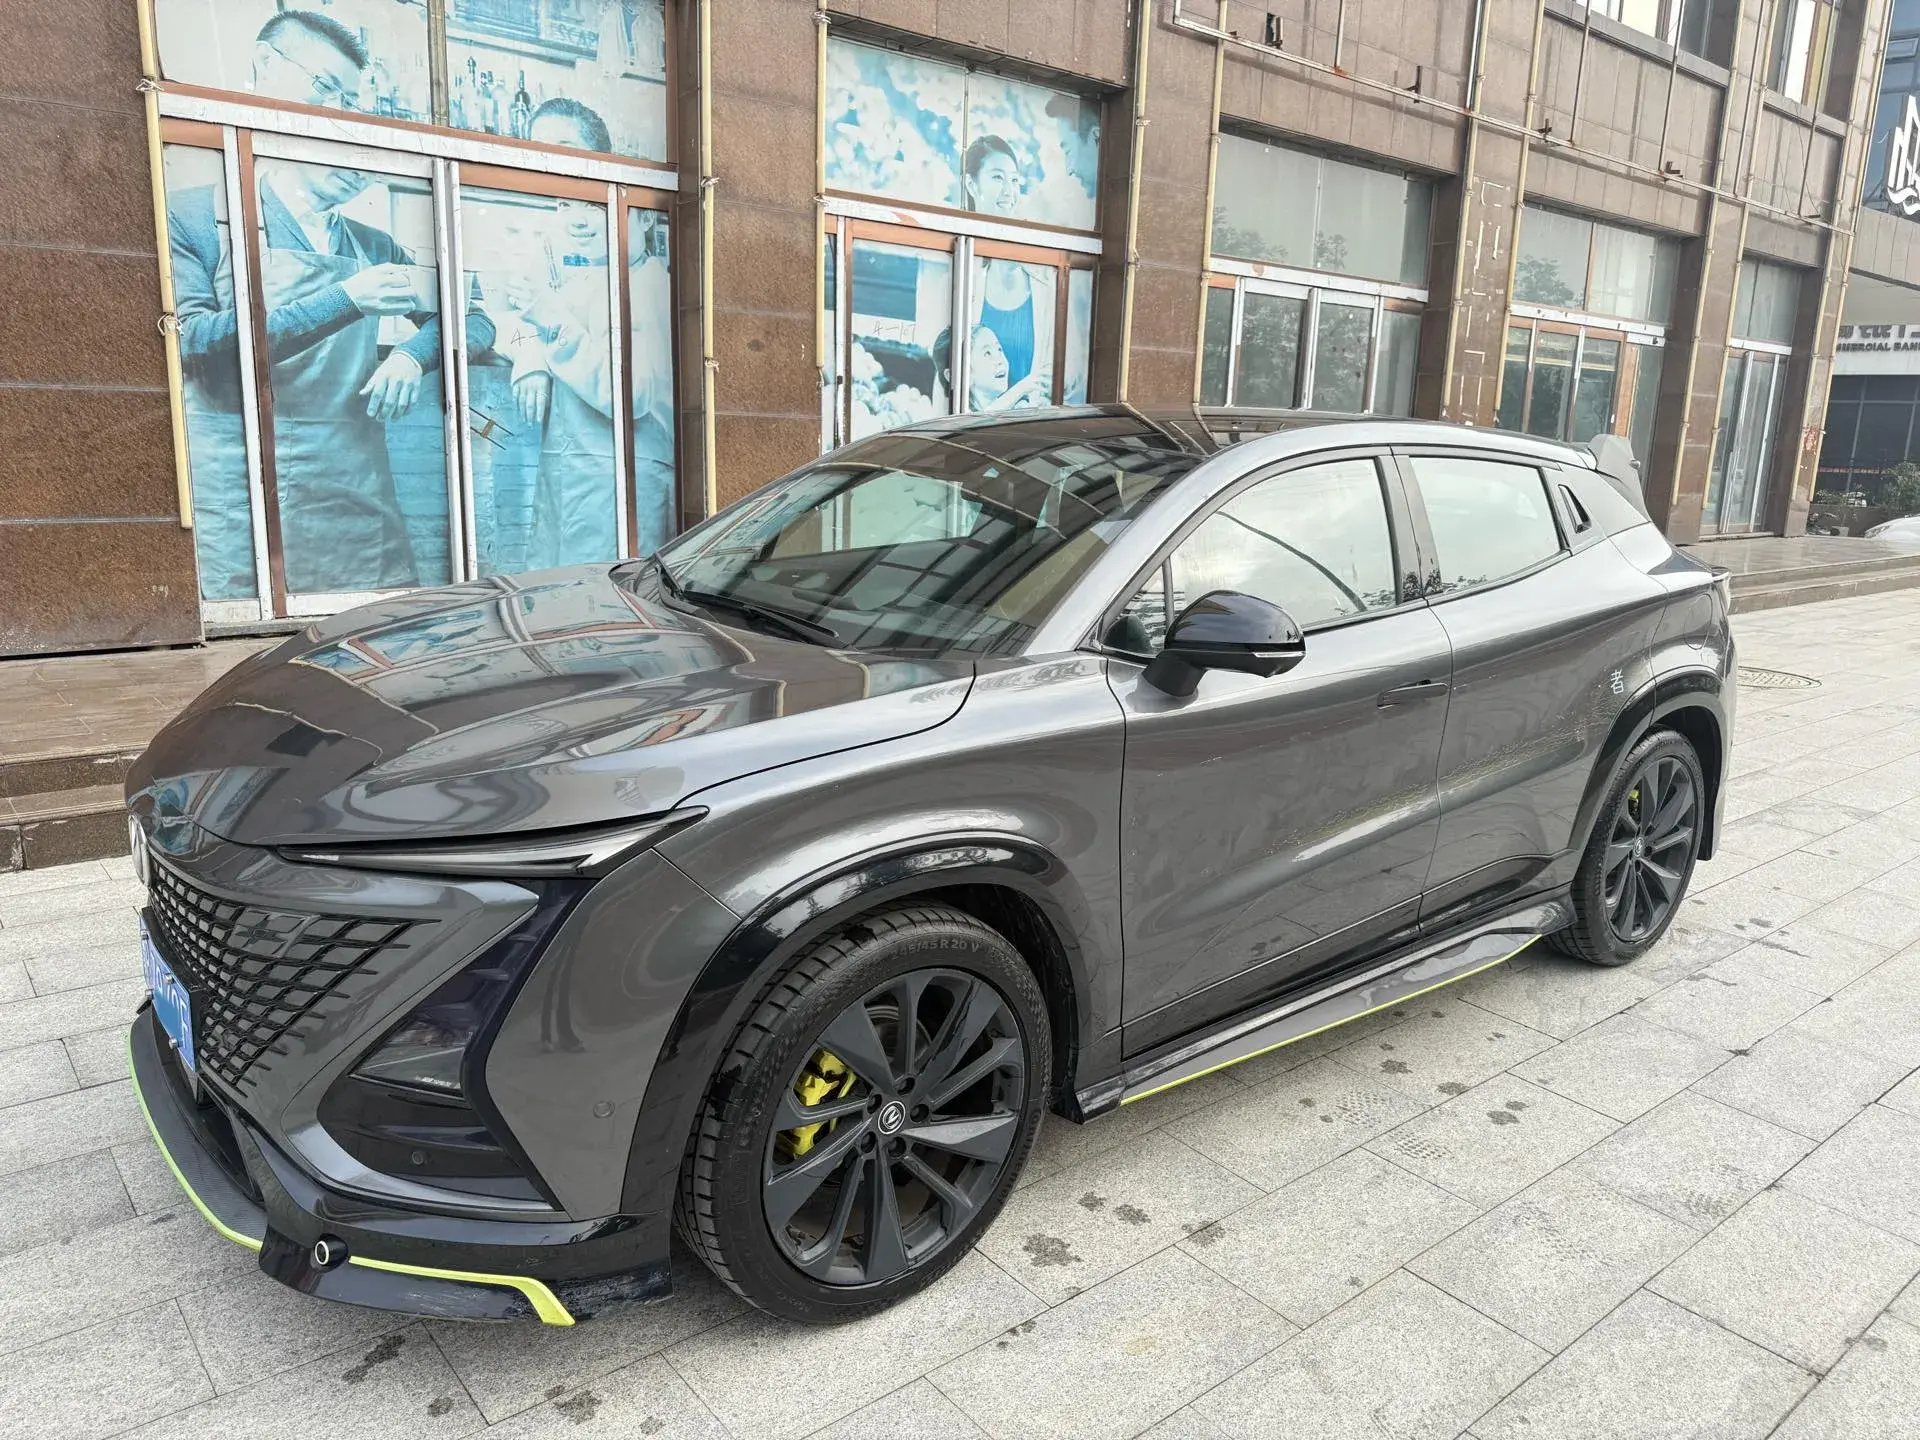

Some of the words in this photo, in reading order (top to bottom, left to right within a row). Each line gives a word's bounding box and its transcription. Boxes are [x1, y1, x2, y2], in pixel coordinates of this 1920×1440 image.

[1610, 667, 1624, 694] 者
[940, 939, 949, 949] R
[951, 939, 968, 950] 20
